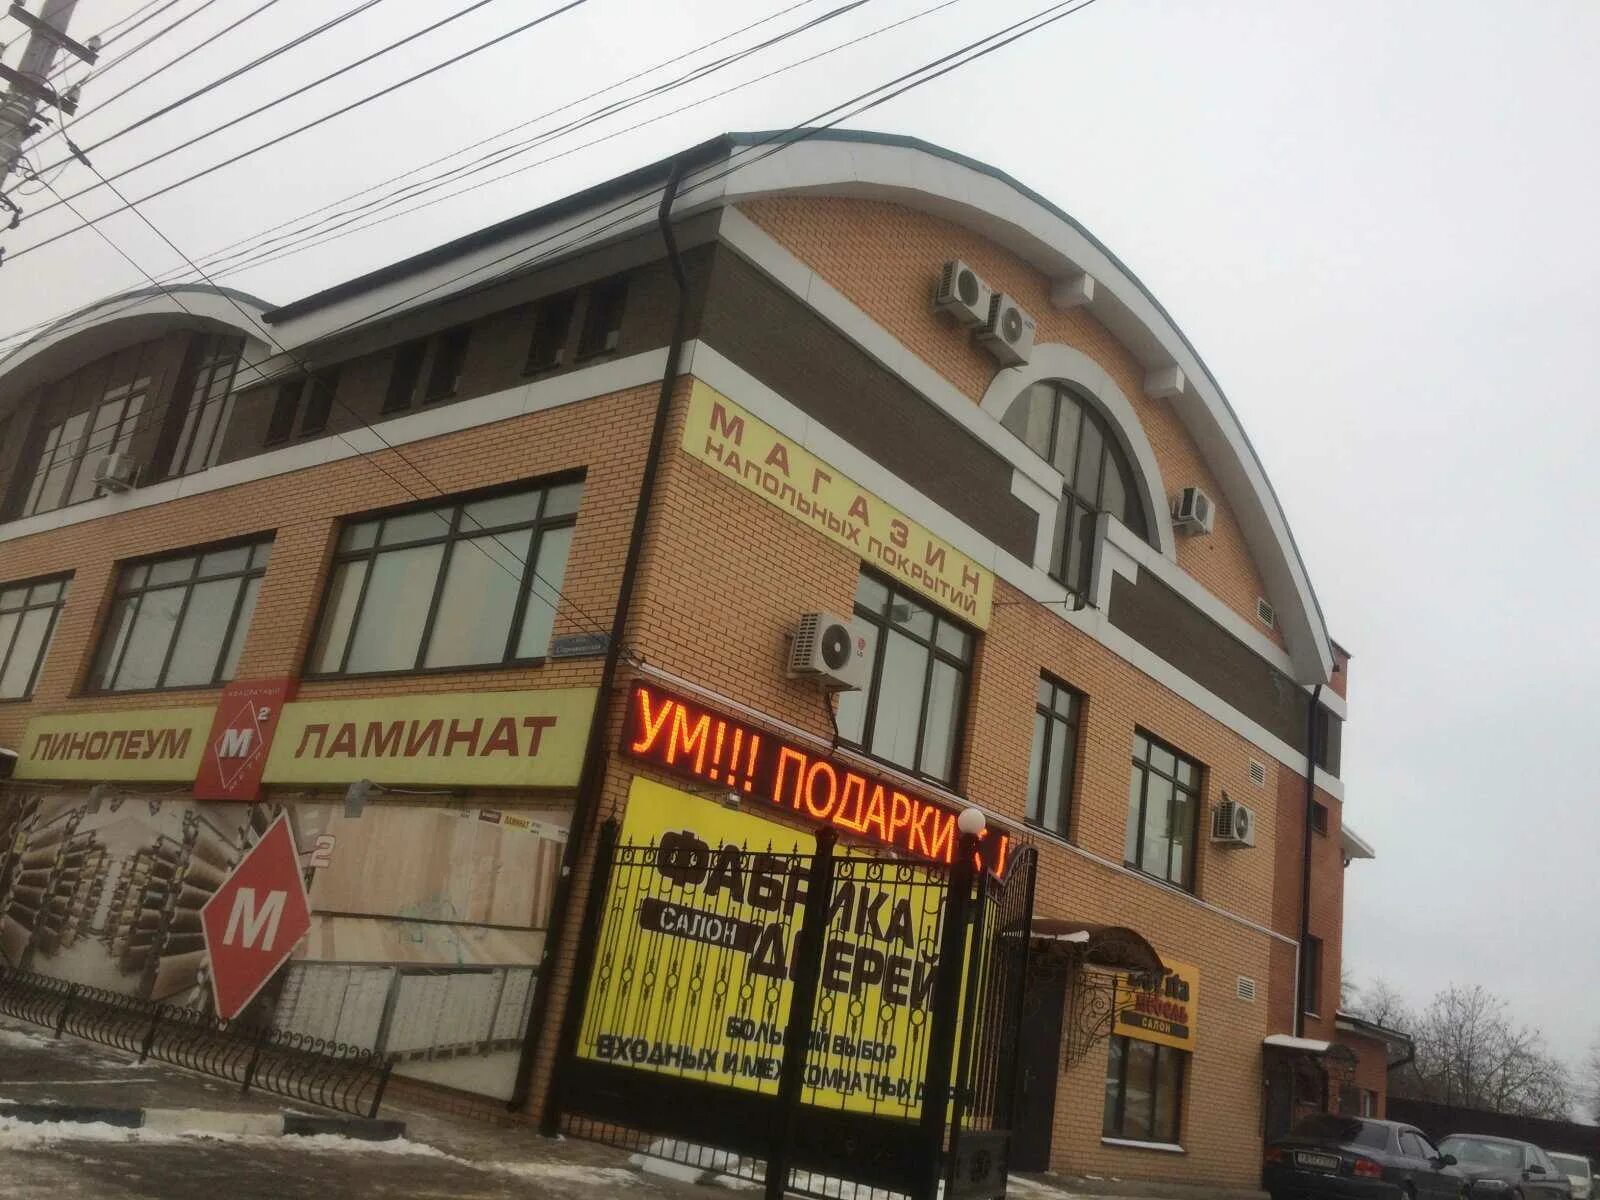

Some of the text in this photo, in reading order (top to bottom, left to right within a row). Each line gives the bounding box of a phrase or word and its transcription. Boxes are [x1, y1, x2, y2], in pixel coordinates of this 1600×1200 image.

[710, 400, 980, 595] МАГАЗИН
[704, 436, 977, 617] НАПОЛЬНЫХ ПОКРЫТИЙ
[30, 727, 193, 762] ЛИНОЛЕУМ
[219, 728, 254, 758] М
[258, 706, 271, 720] 2
[294, 715, 558, 760] ЛАМИНАТ
[633, 688, 760, 792] УМ!!!
[773, 747, 956, 864] ПОДАРКИ
[222, 833, 337, 952] М 2
[660, 907, 738, 945] САЛОН
[597, 1034, 719, 1073] ВХОДНЫХ
[722, 1051, 738, 1076] И
[726, 1016, 897, 1063] БОЛЬЙ ВЫБОР
